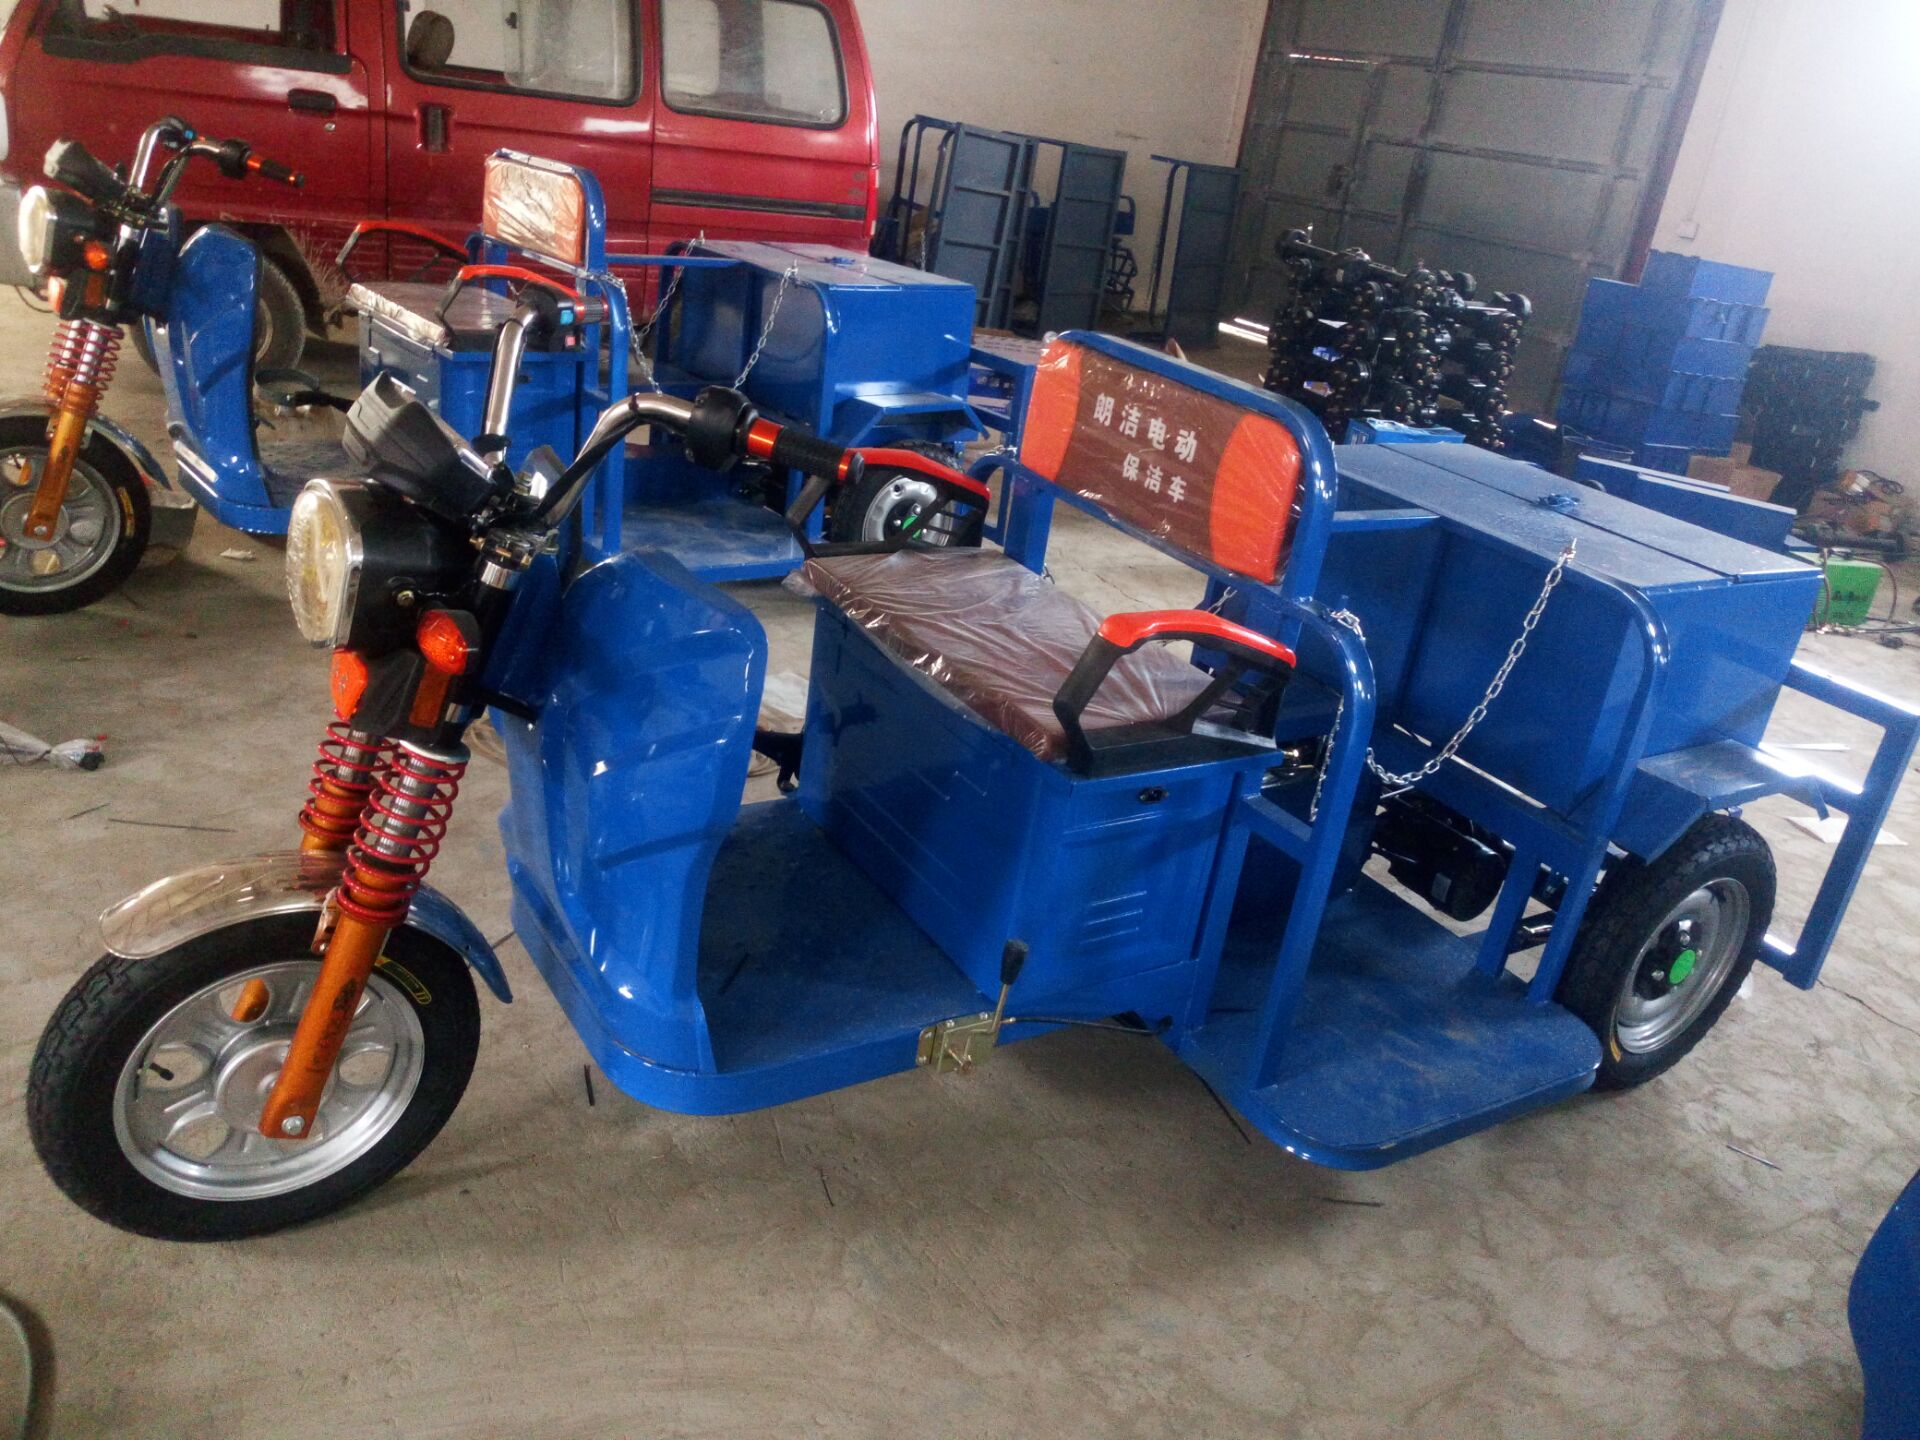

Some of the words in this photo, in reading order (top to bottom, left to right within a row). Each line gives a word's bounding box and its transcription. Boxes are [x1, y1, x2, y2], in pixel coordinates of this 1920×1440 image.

[1093, 392, 1198, 463] 朗洁电动
[1122, 452, 1187, 503] 保洁车
